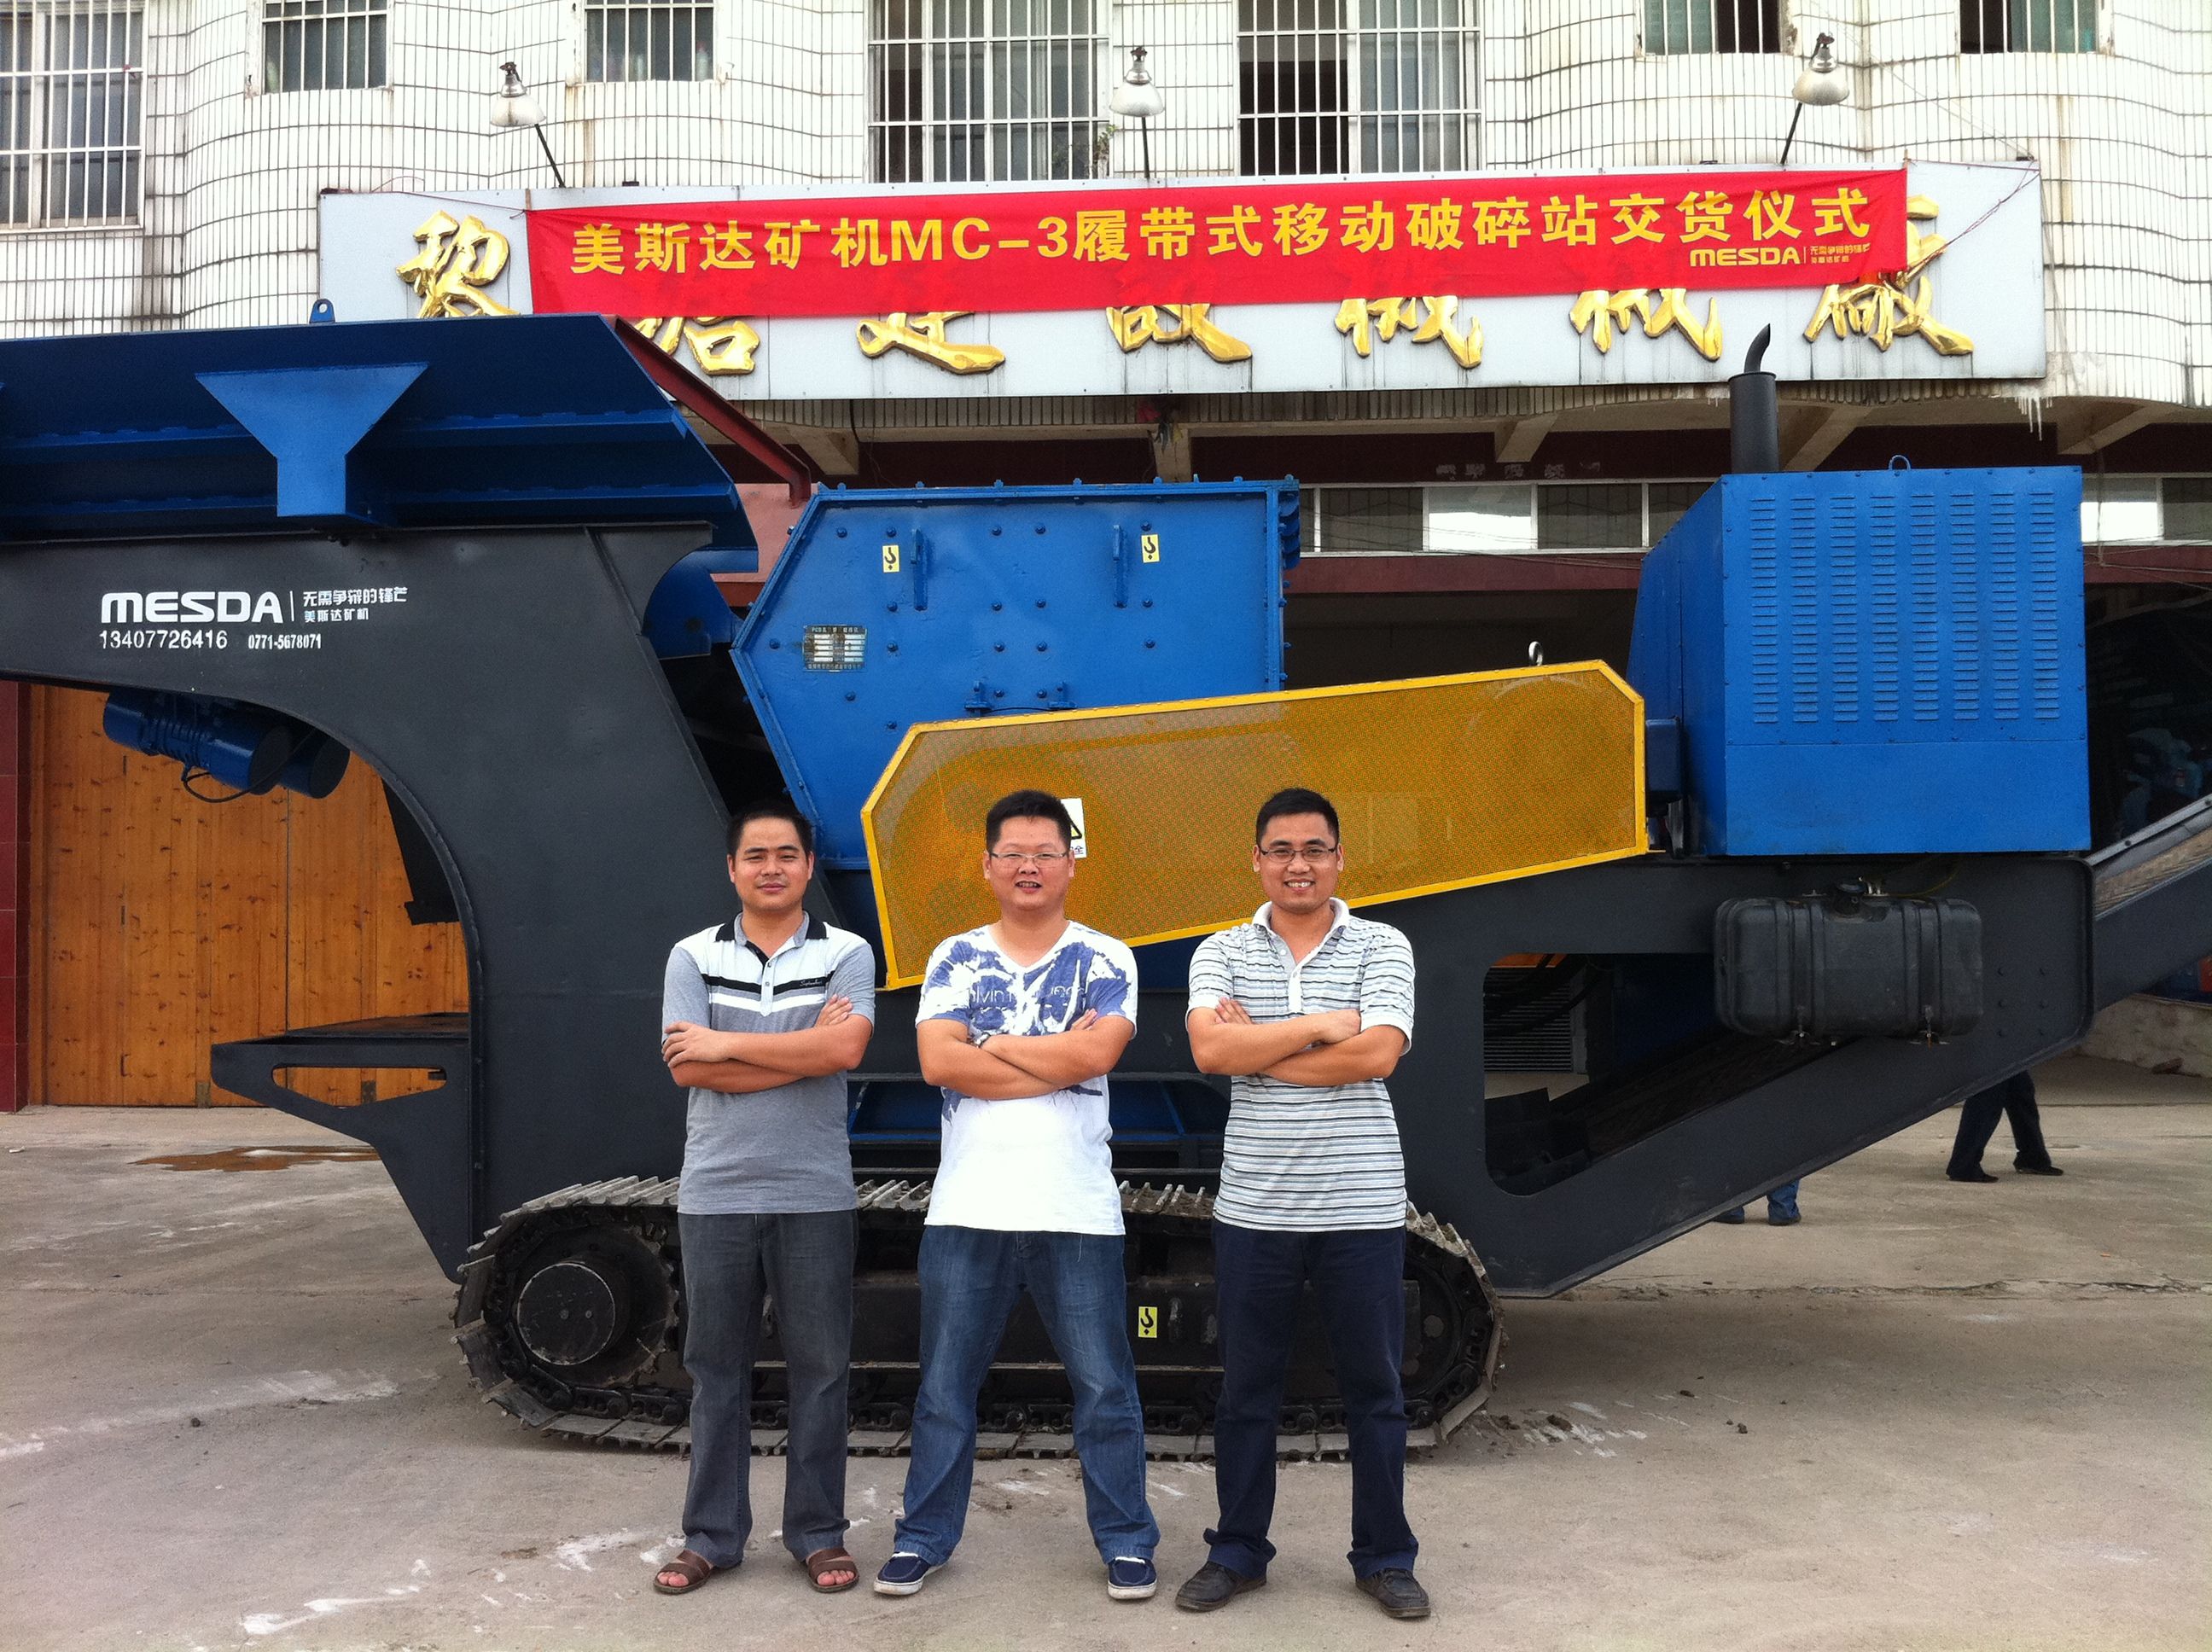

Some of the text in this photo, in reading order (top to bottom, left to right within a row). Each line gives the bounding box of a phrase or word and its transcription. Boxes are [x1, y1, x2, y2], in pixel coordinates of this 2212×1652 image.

[570, 187, 1871, 276] 美斯达矿机MC-3履带式移动破碎站交货仪式
[1690, 246, 1801, 267] MESDA
[101, 590, 283, 624] MESDA
[304, 607, 370, 623] 美斯达矿机
[99, 630, 323, 650] 13407726416 0771-5678071
